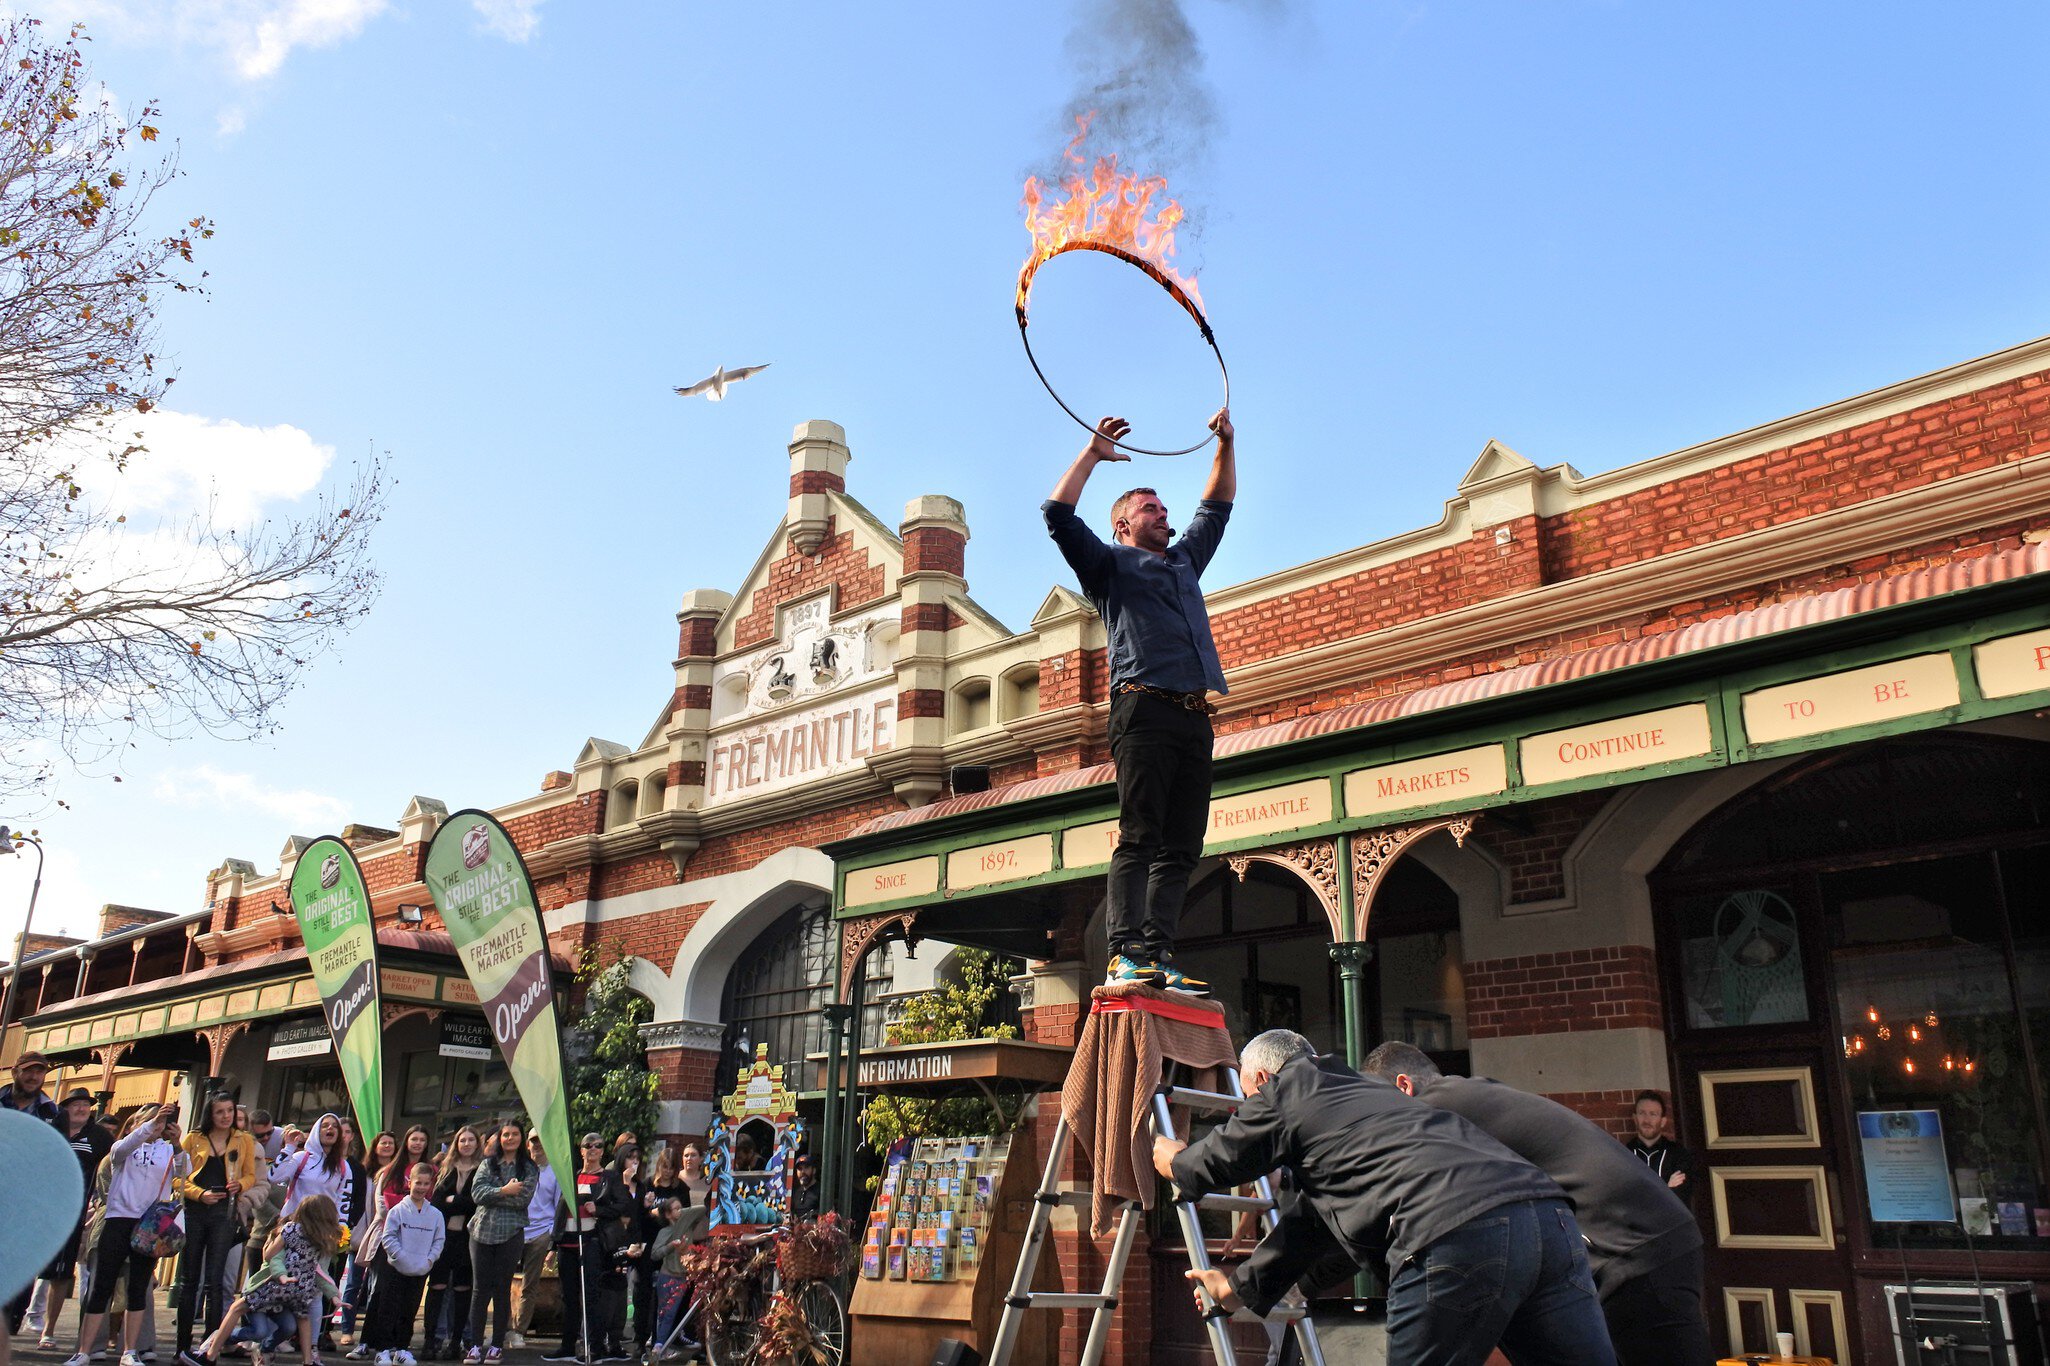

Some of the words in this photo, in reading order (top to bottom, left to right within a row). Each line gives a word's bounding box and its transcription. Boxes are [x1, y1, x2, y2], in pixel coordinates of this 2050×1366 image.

[790, 602, 821, 626] 1897
[710, 697, 894, 796] FREMANTLE
[980, 849, 1018, 873] 1897,
[1212, 796, 1309, 828] FREMANTLE
[1377, 767, 1470, 798] MARKETS
[1558, 728, 1665, 764] CONTINUE
[1784, 699, 1815, 720] TO
[1874, 680, 1910, 703] BE
[442, 870, 460, 888] THE
[445, 863, 508, 911] ORIGINAL
[305, 890, 317, 903] THE
[305, 887, 352, 921] ORIGINAL
[458, 900, 480, 919] STILL
[481, 877, 520, 917] BEST
[314, 915, 330, 930] STILL
[331, 900, 358, 929] BEST
[468, 912, 480, 923] THE
[320, 936, 361, 965] FREMANTLE
[470, 923, 527, 961] FREMANTLE
[325, 951, 357, 974] MARKETS
[477, 941, 524, 973] MARKETS
[391, 983, 418, 992] FRIDAY
[412, 977, 432, 986] OPEN
[332, 963, 371, 1031] Open!
[495, 954, 546, 1043] Open!
[274, 1030, 288, 1042] WILD
[289, 1028, 307, 1040] EARTH
[309, 1025, 330, 1037] IMAGES
[444, 1023, 465, 1033] WILD
[452, 1034, 483, 1045] IMAGES
[859, 1055, 951, 1083] NFORMATION
